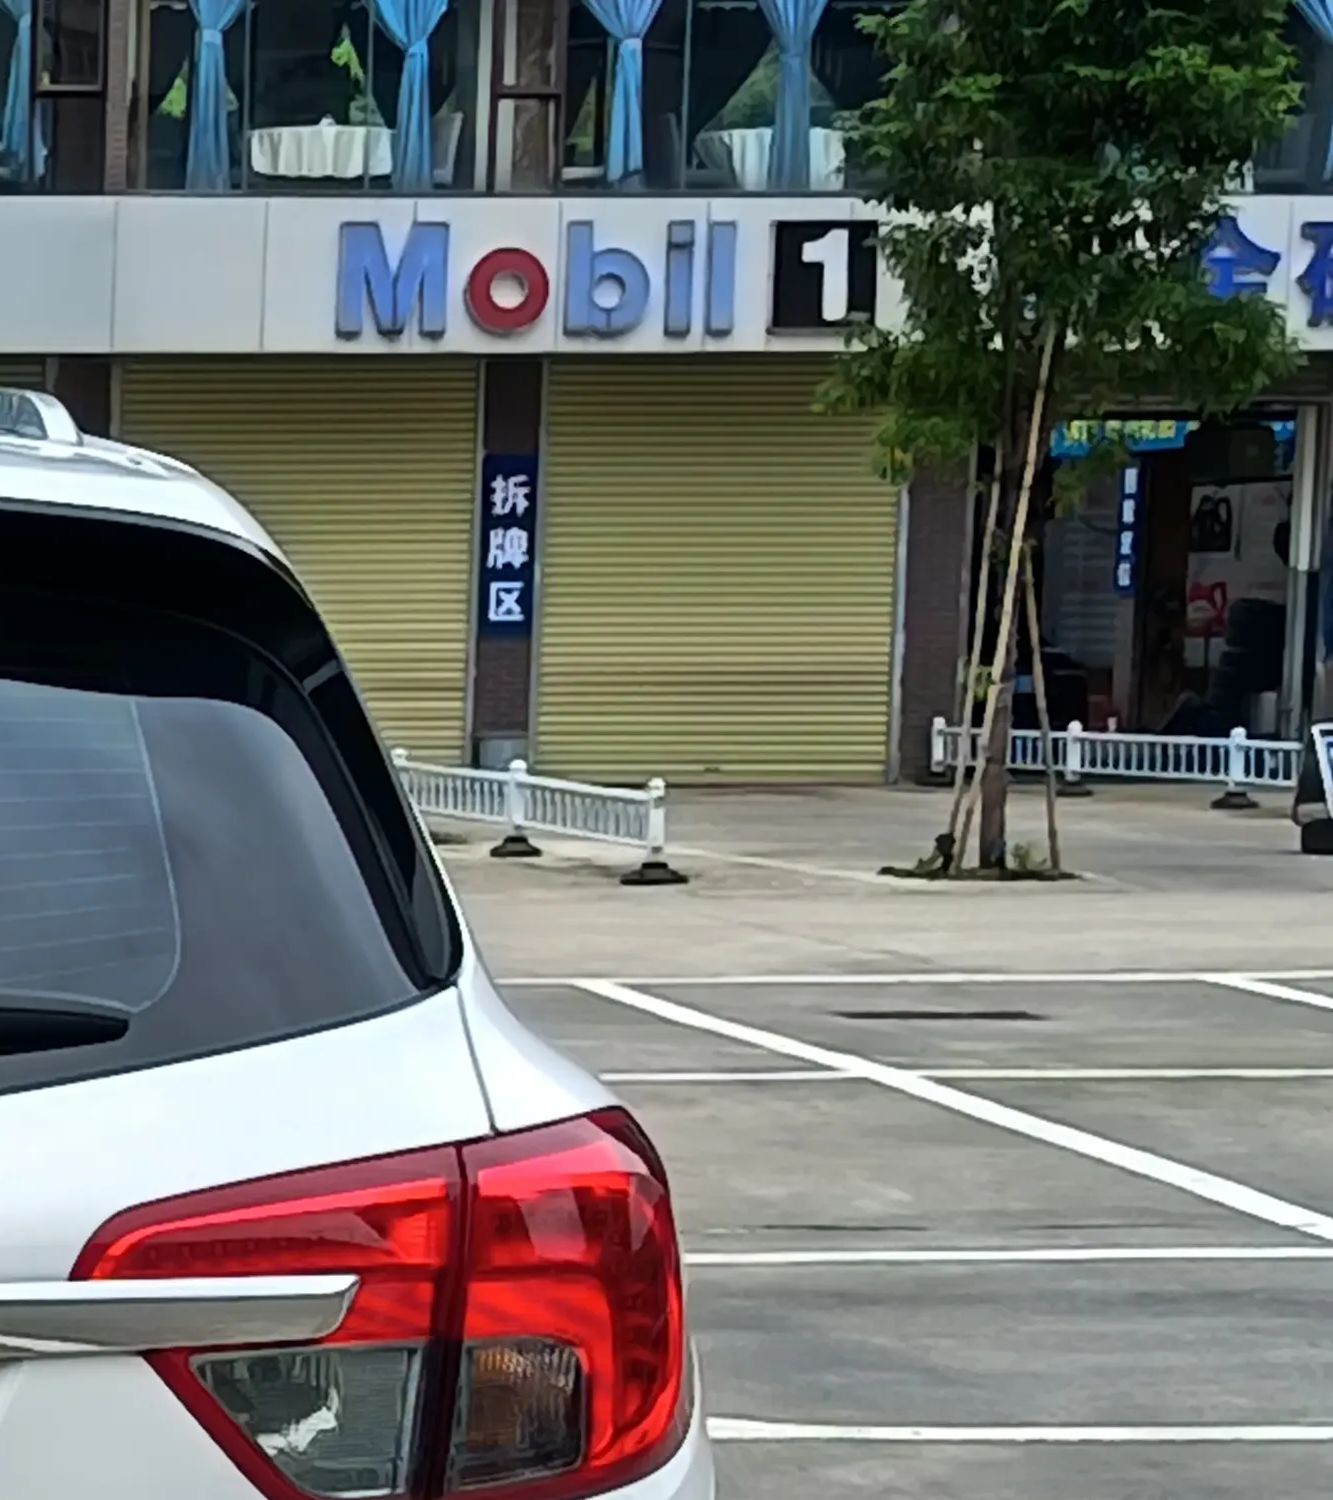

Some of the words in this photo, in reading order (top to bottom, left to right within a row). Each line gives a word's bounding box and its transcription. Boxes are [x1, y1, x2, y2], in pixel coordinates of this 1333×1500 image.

[335, 221, 737, 340] Mobil
[801, 228, 850, 322] 1
[486, 474, 531, 622] 拆牌区
